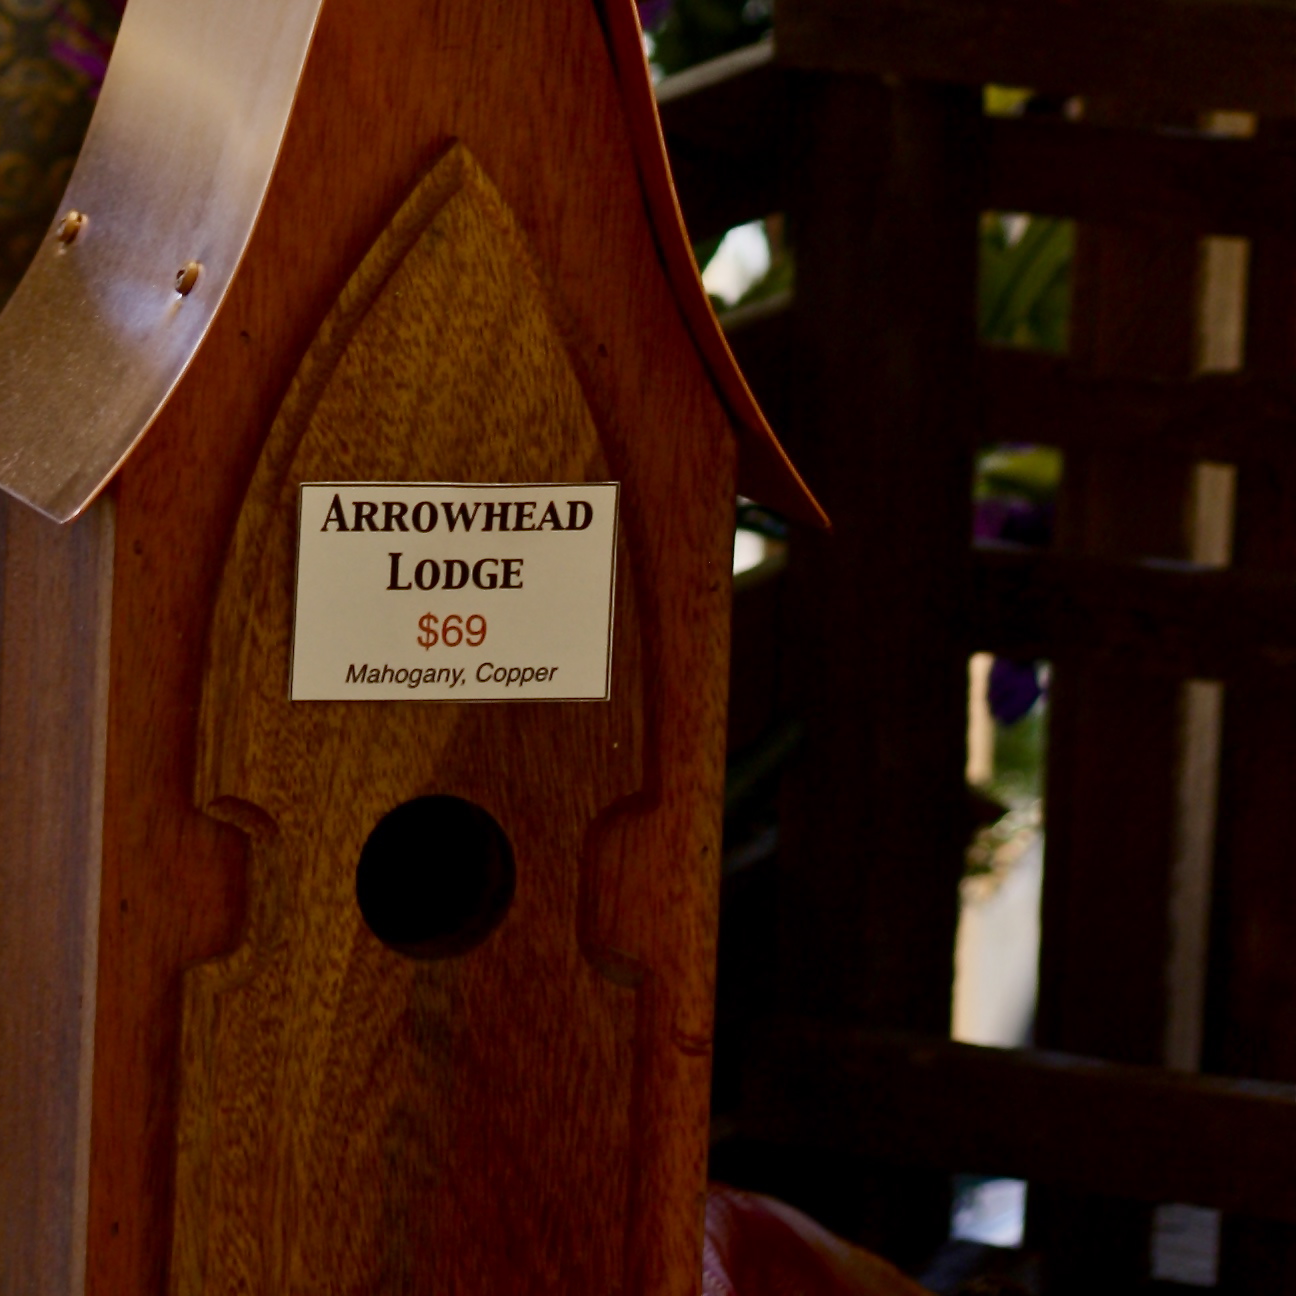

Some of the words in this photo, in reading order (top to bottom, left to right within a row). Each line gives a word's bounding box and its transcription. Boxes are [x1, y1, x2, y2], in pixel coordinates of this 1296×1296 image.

[320, 493, 594, 533] ARROWHEAD
[386, 552, 524, 591] LODGE
[417, 612, 488, 651] $69
[345, 663, 466, 688] Mahogany,
[475, 662, 559, 687] Copper
